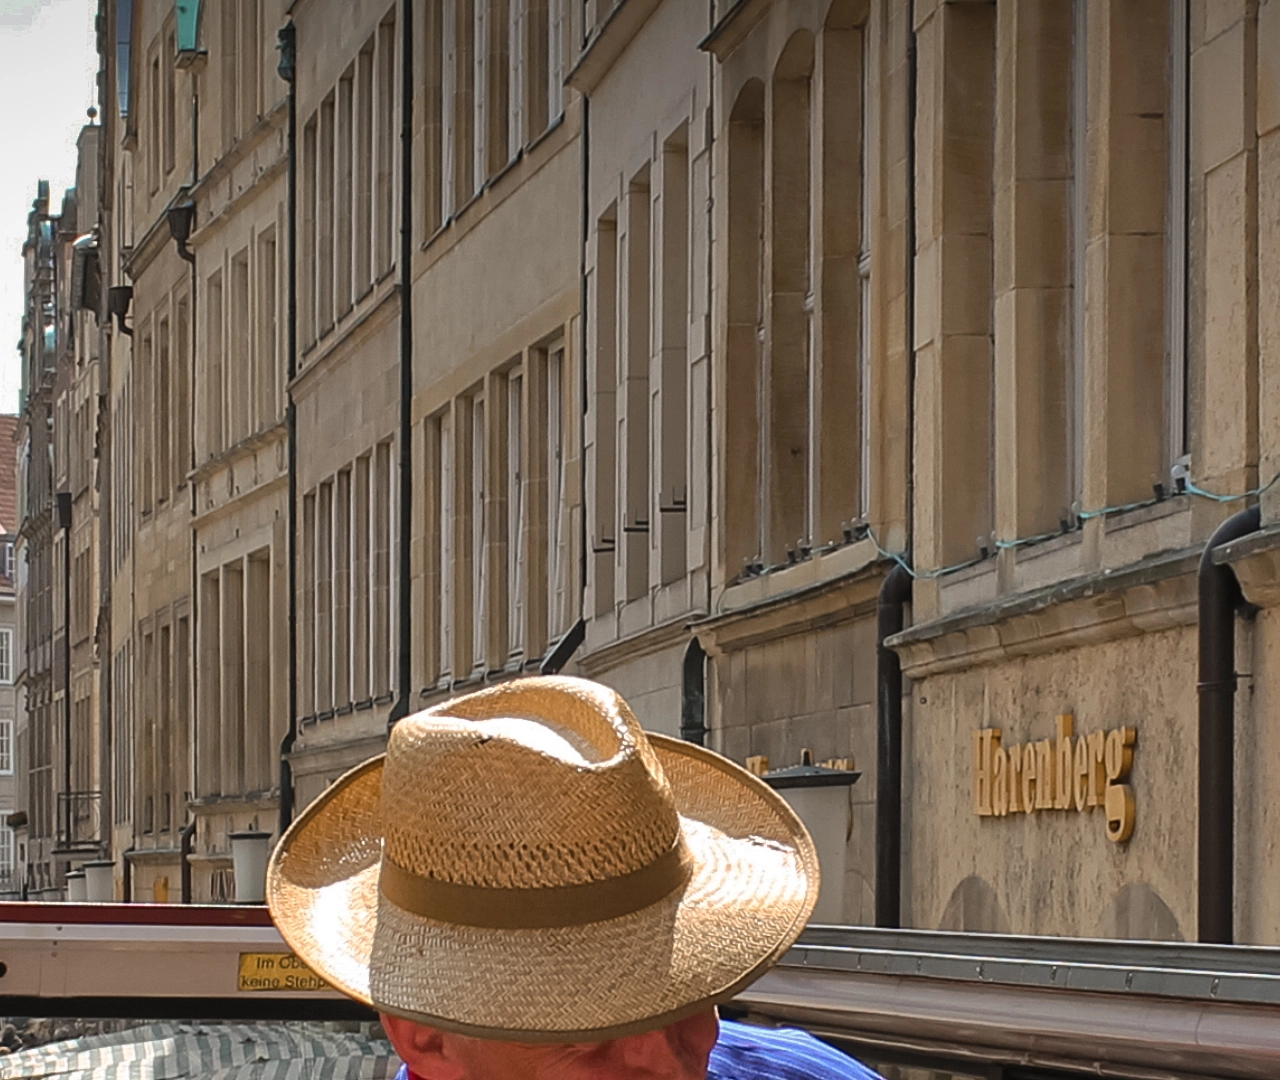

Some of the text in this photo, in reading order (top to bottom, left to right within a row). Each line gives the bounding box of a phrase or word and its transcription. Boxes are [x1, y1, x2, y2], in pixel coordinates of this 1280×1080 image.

[973, 715, 1137, 842] Harenberg
[256, 957, 275, 969] Im
[241, 975, 328, 988] keine Stehp
